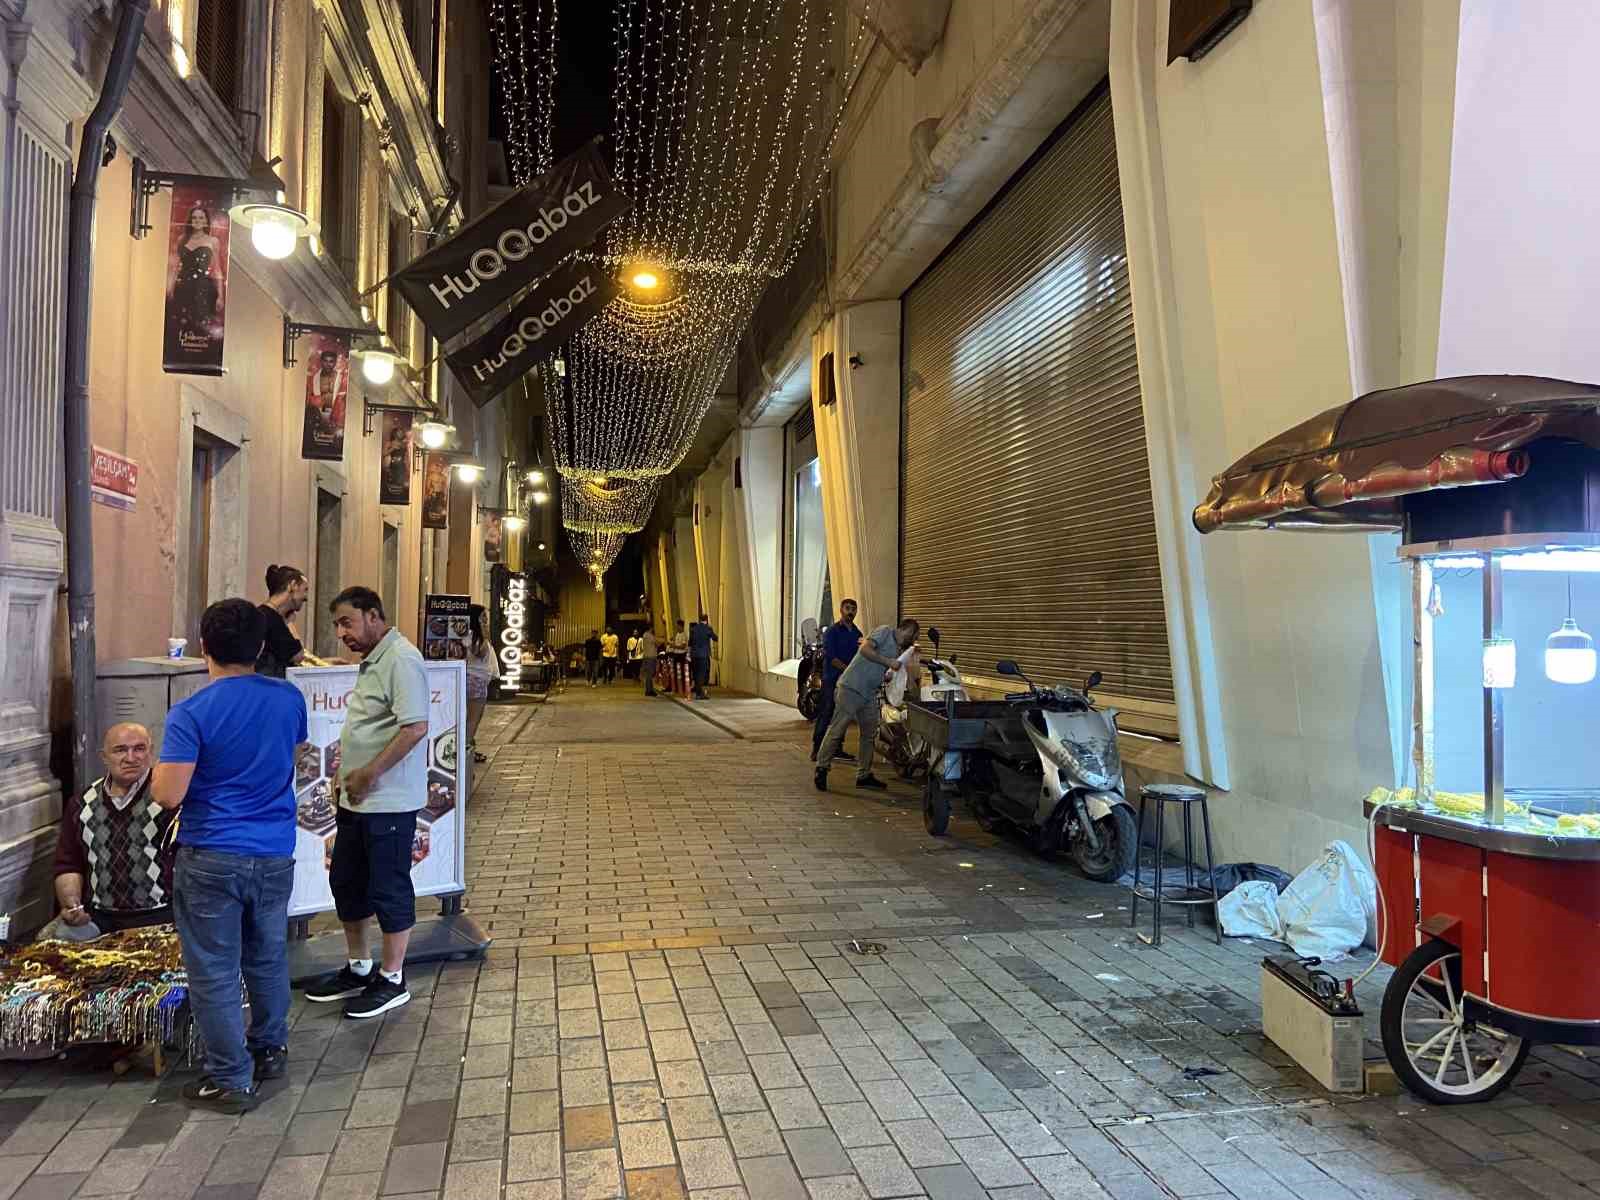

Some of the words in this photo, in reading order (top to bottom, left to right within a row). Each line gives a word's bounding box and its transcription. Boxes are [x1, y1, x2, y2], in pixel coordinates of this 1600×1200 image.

[429, 181, 602, 309] HuQQabaz
[472, 276, 598, 381] HuQQabaz
[500, 578, 525, 689] HuQQabaz
